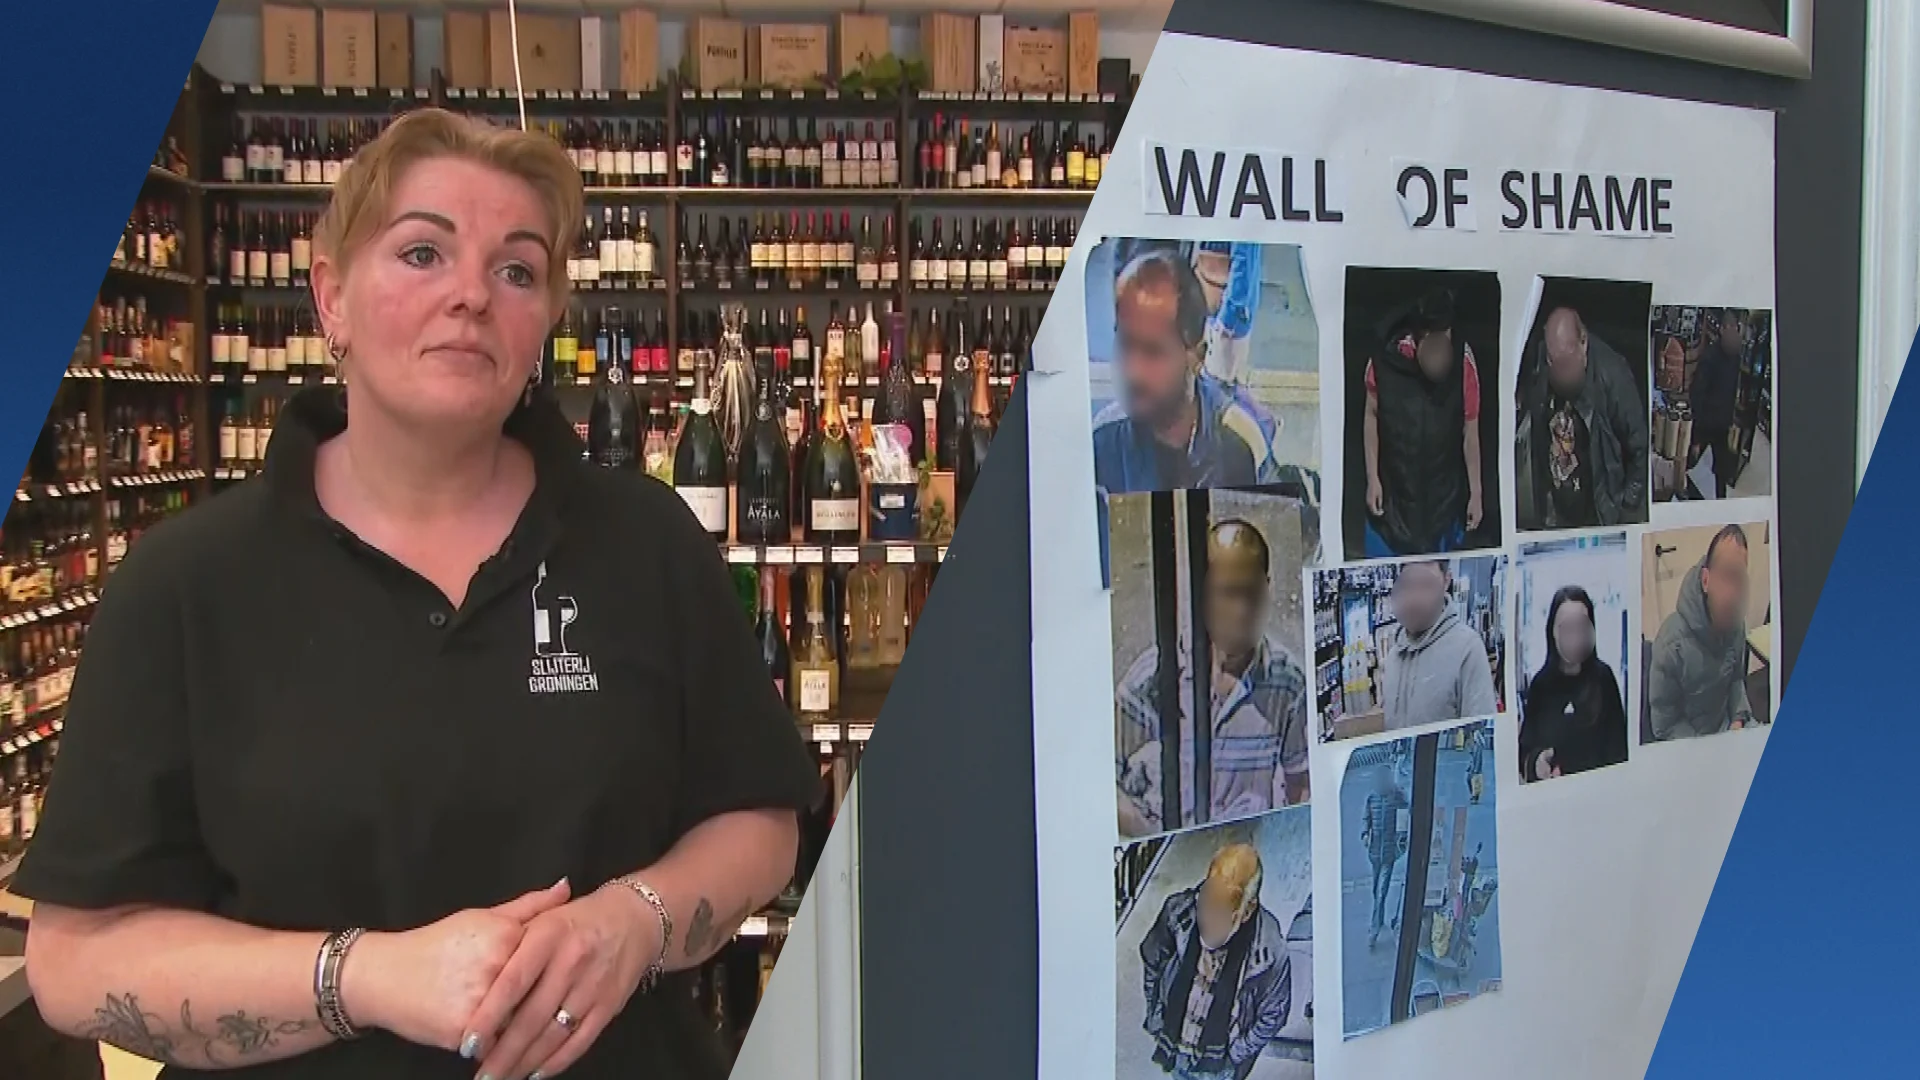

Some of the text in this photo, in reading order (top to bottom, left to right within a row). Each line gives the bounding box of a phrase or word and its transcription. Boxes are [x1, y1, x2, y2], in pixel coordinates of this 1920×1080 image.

[1154, 146, 1673, 233] WALL OF SHAME
[747, 503, 781, 520] AYALA
[531, 655, 591, 675] SLIJTERIJ
[528, 673, 599, 693] GRONINGEN
